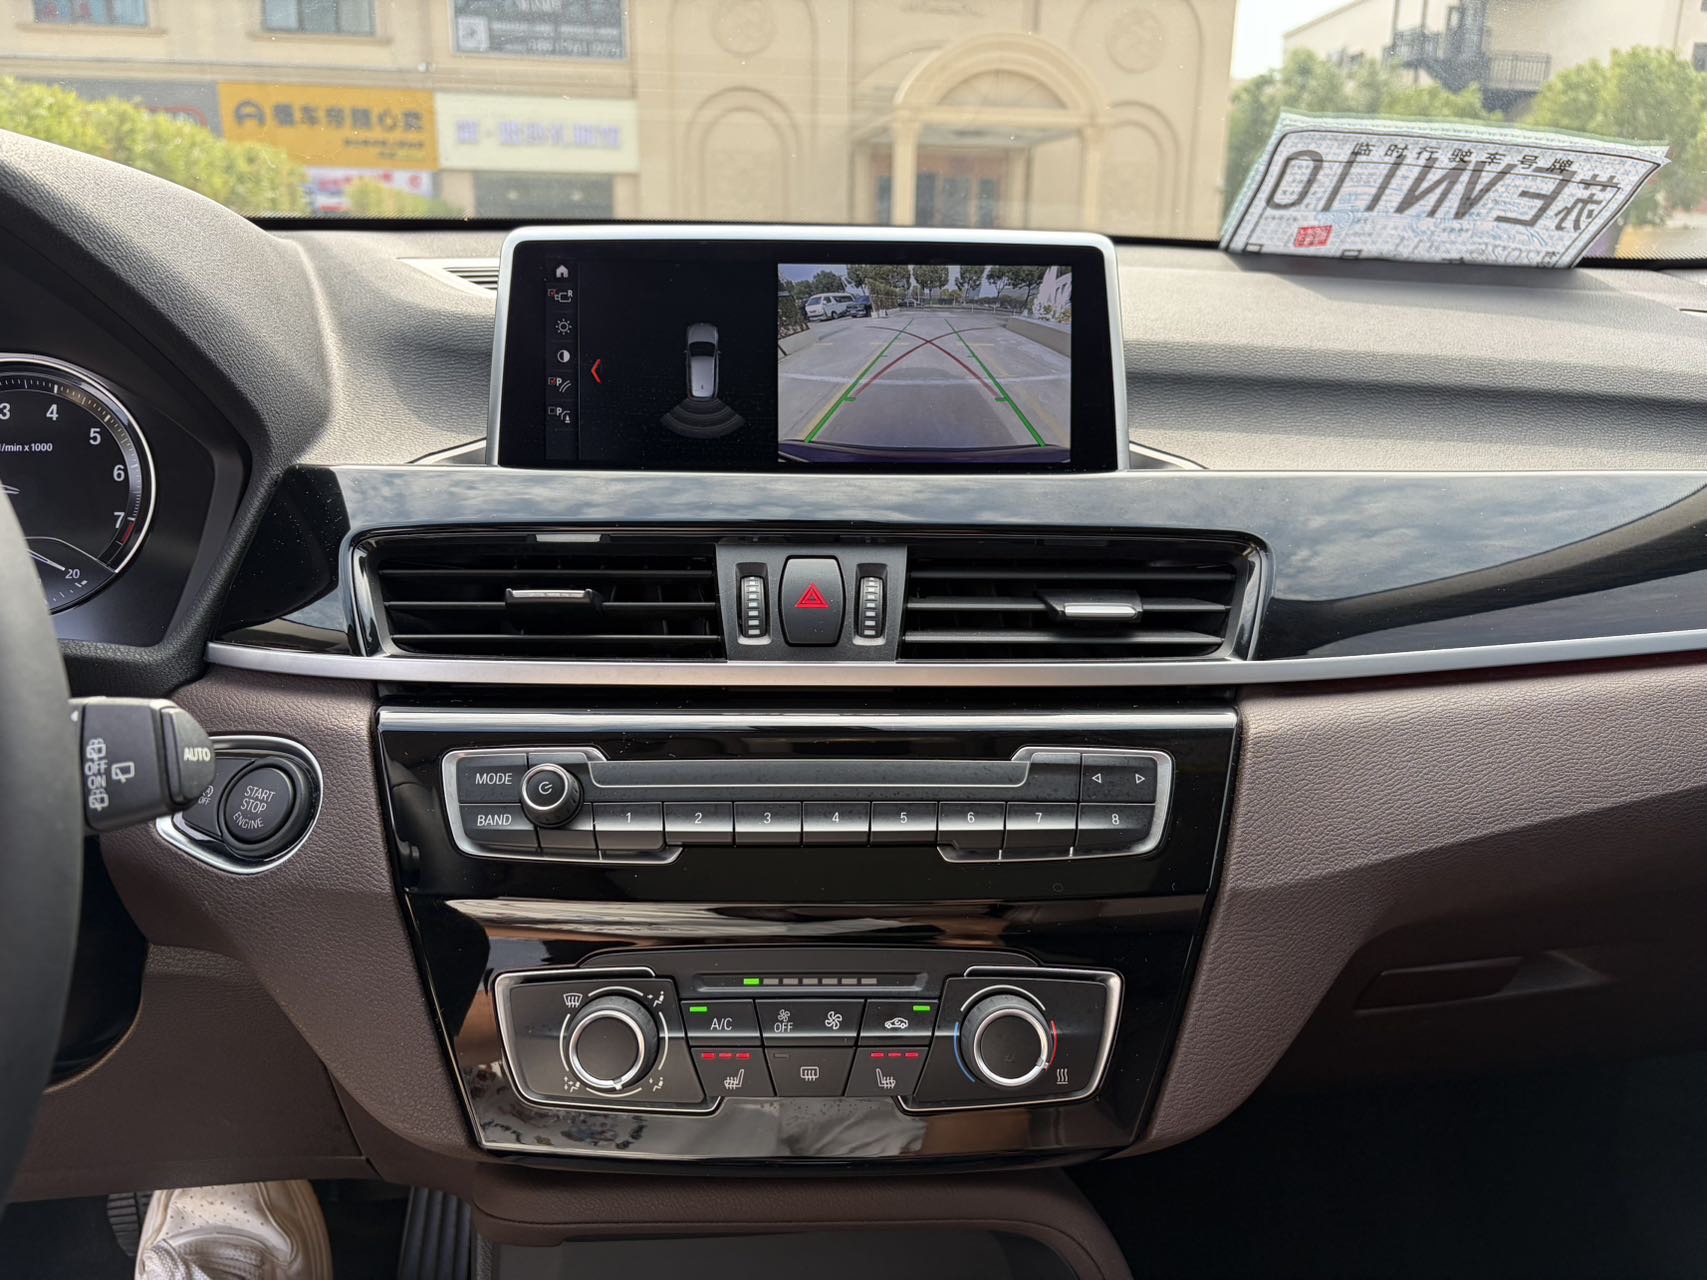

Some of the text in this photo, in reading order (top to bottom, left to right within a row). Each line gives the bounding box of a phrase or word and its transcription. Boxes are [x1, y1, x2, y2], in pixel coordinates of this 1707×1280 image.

[1351, 142, 1573, 173] 临时行驶车号牌
[0, 402, 10, 420] 3
[46, 403, 59, 421] 4
[89, 428, 101, 445] 5
[31, 443, 53, 452] 1000
[113, 464, 125, 481] 6
[114, 512, 125, 528] 7
[65, 568, 80, 579] 20
[183, 747, 211, 761] AUTO
[85, 760, 108, 775] OFF
[87, 775, 106, 789] ON
[475, 773, 513, 785] MODE
[244, 785, 276, 802] START
[241, 798, 267, 814] STOP
[233, 811, 264, 829] ENGINE
[476, 814, 512, 827] BAND
[625, 813, 632, 824] 1
[694, 813, 703, 824] 2
[763, 813, 772, 824] 3
[832, 813, 840, 824] 4
[900, 813, 908, 824] 5
[967, 813, 975, 824] 6
[1035, 813, 1043, 824] 7
[1111, 813, 1120, 825] 8
[711, 1017, 732, 1031] A/C
[774, 1022, 793, 1033] OFF
